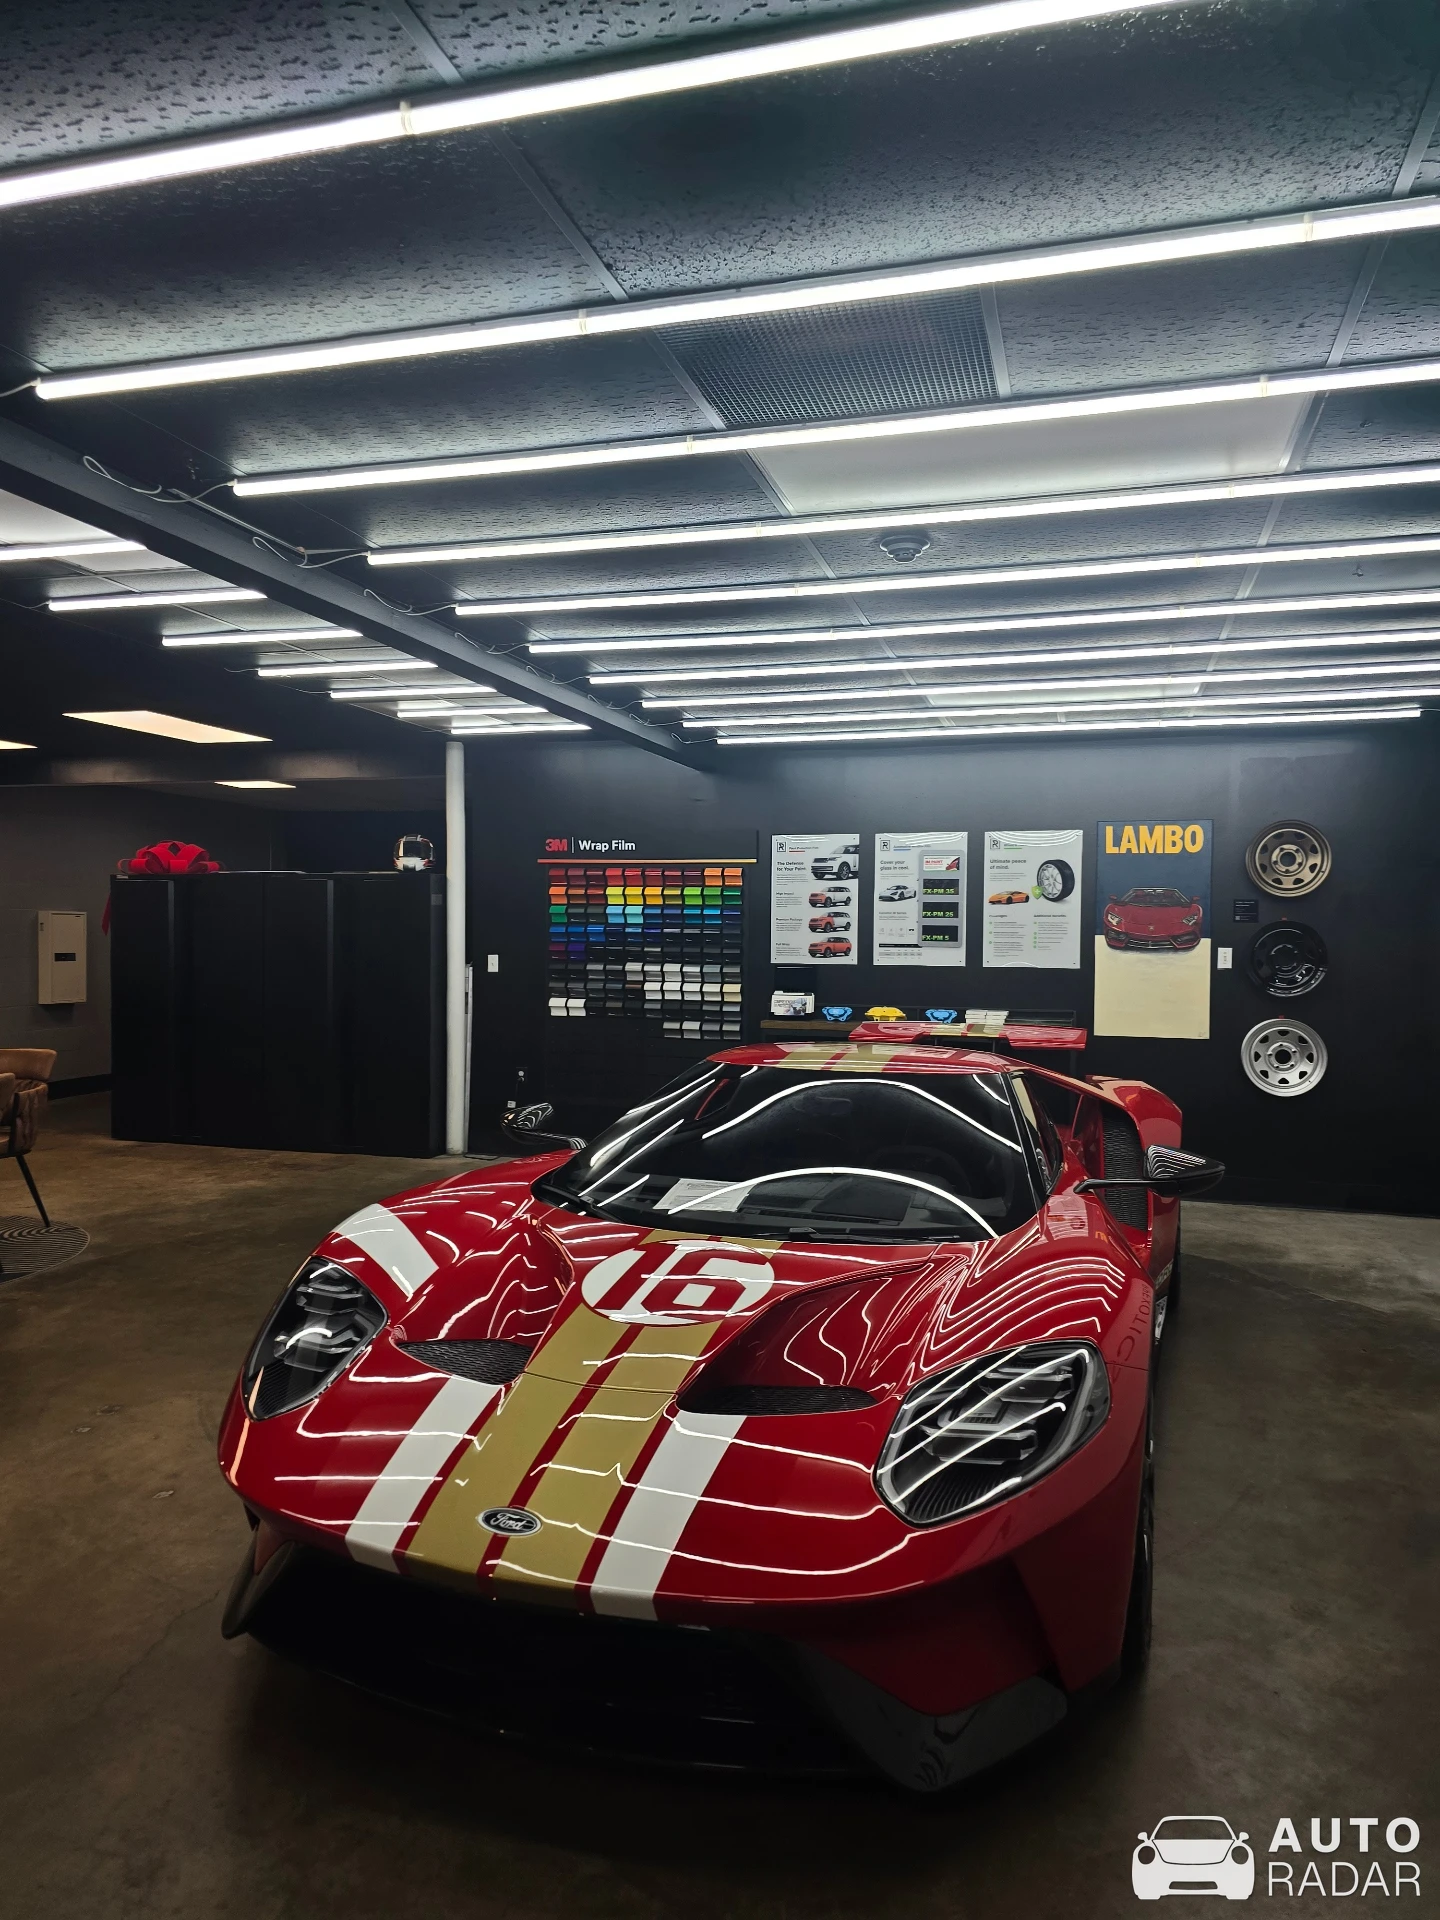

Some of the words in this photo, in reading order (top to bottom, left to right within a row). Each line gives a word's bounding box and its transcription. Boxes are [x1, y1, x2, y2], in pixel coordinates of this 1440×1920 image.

[545, 839, 568, 851] 3M
[578, 840, 609, 852] Wrap
[611, 840, 636, 850] Film
[1105, 824, 1204, 854] LAMBO
[593, 1243, 767, 1322] 16
[490, 1512, 527, 1530] Ford
